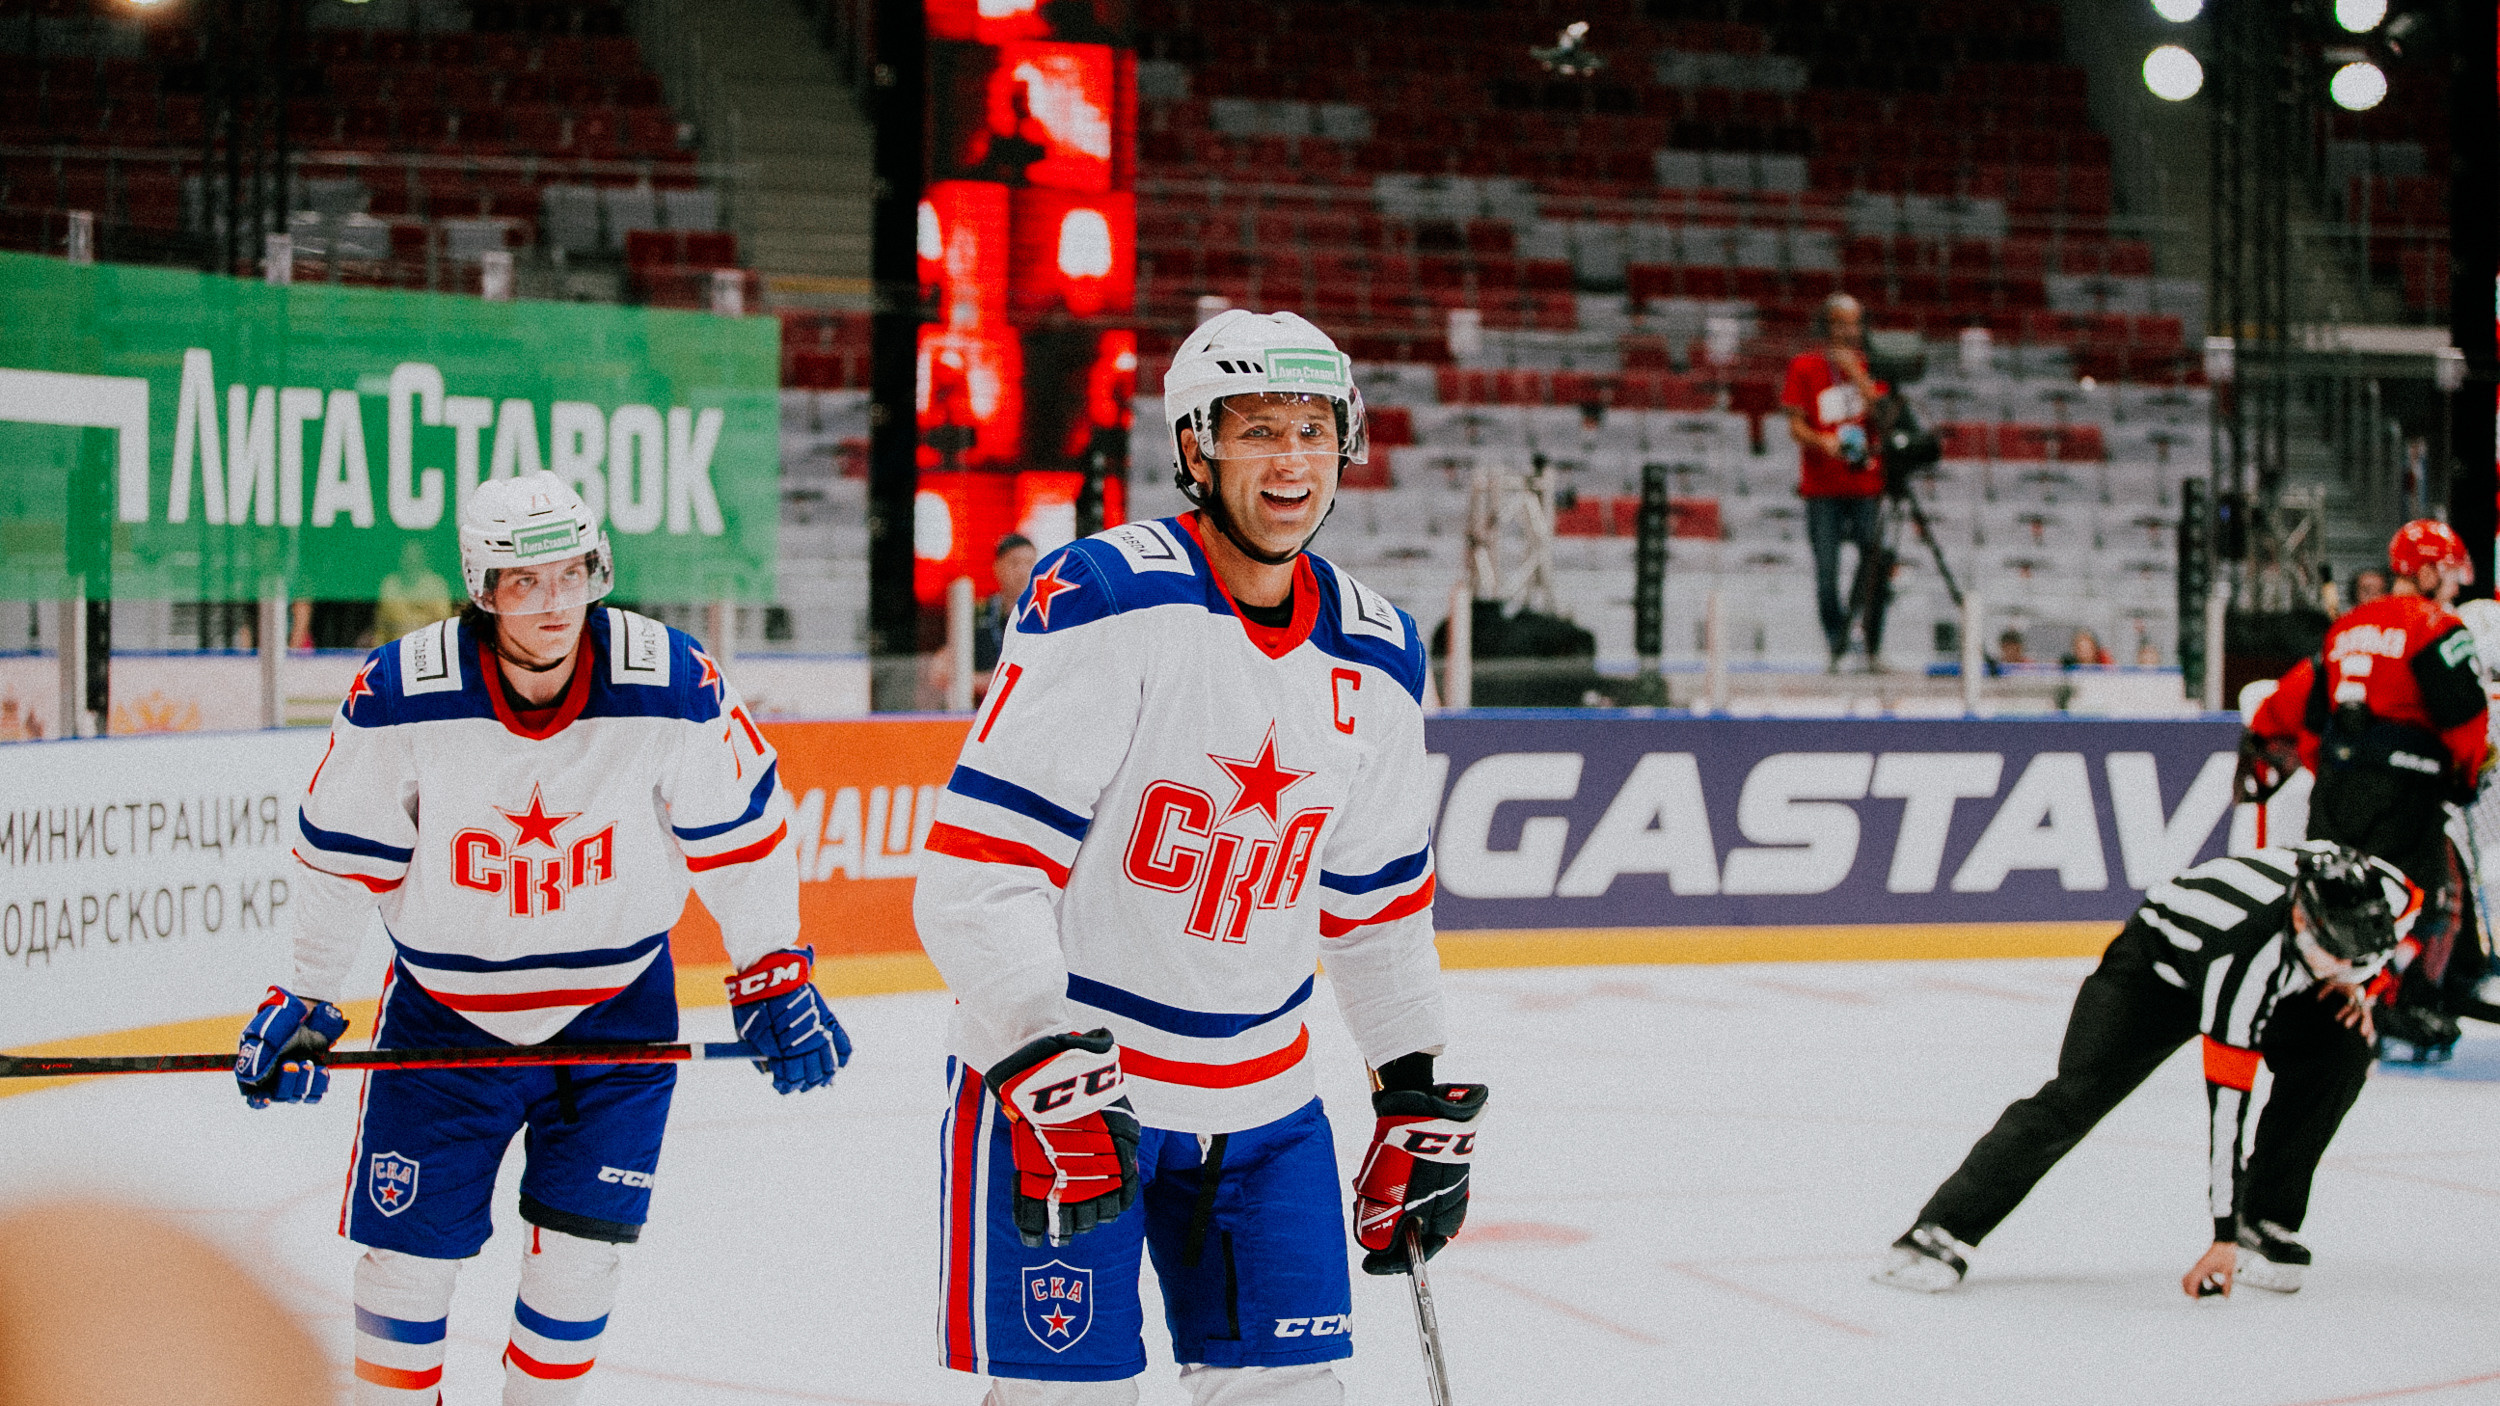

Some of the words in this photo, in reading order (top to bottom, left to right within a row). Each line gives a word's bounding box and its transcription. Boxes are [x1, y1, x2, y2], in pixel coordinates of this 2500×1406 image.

[1427, 751, 2239, 899] GASTAV
[1028, 1061, 1124, 1114] CC
[1274, 1313, 1352, 1338] CCM
